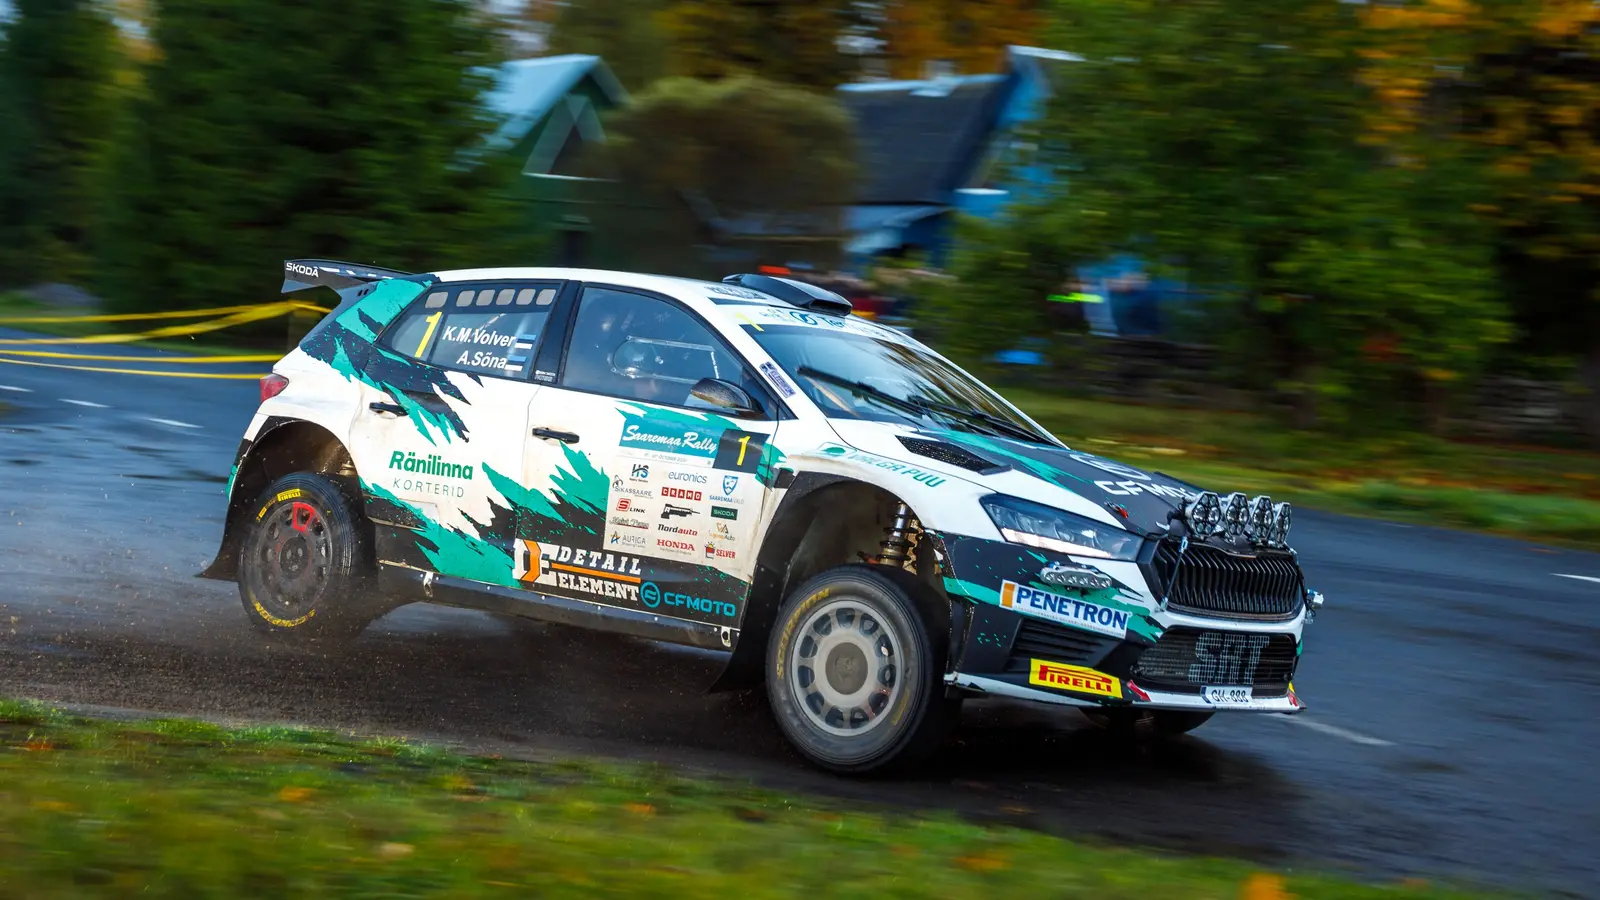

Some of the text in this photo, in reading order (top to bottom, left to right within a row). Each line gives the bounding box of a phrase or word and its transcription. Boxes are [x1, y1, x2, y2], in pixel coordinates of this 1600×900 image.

[415, 312, 442, 358] 1
[442, 326, 516, 347] K.M.Volver
[456, 350, 507, 370] A.Sõna
[622, 425, 682, 447] Saaremaa
[680, 432, 718, 454] Rally
[737, 435, 751, 466] 1
[389, 450, 474, 480] Ränilinna
[668, 470, 708, 484] euronics
[901, 468, 947, 487] PUU
[392, 478, 464, 498] KORTERID
[656, 538, 696, 552] HONDA
[716, 549, 737, 559] SELVER
[558, 546, 641, 575] DETAIL
[557, 571, 640, 601] ELEMENT
[663, 592, 736, 617] CFMOTO
[1016, 586, 1128, 631] PENETRON
[1038, 664, 1112, 692] PIRELLI
